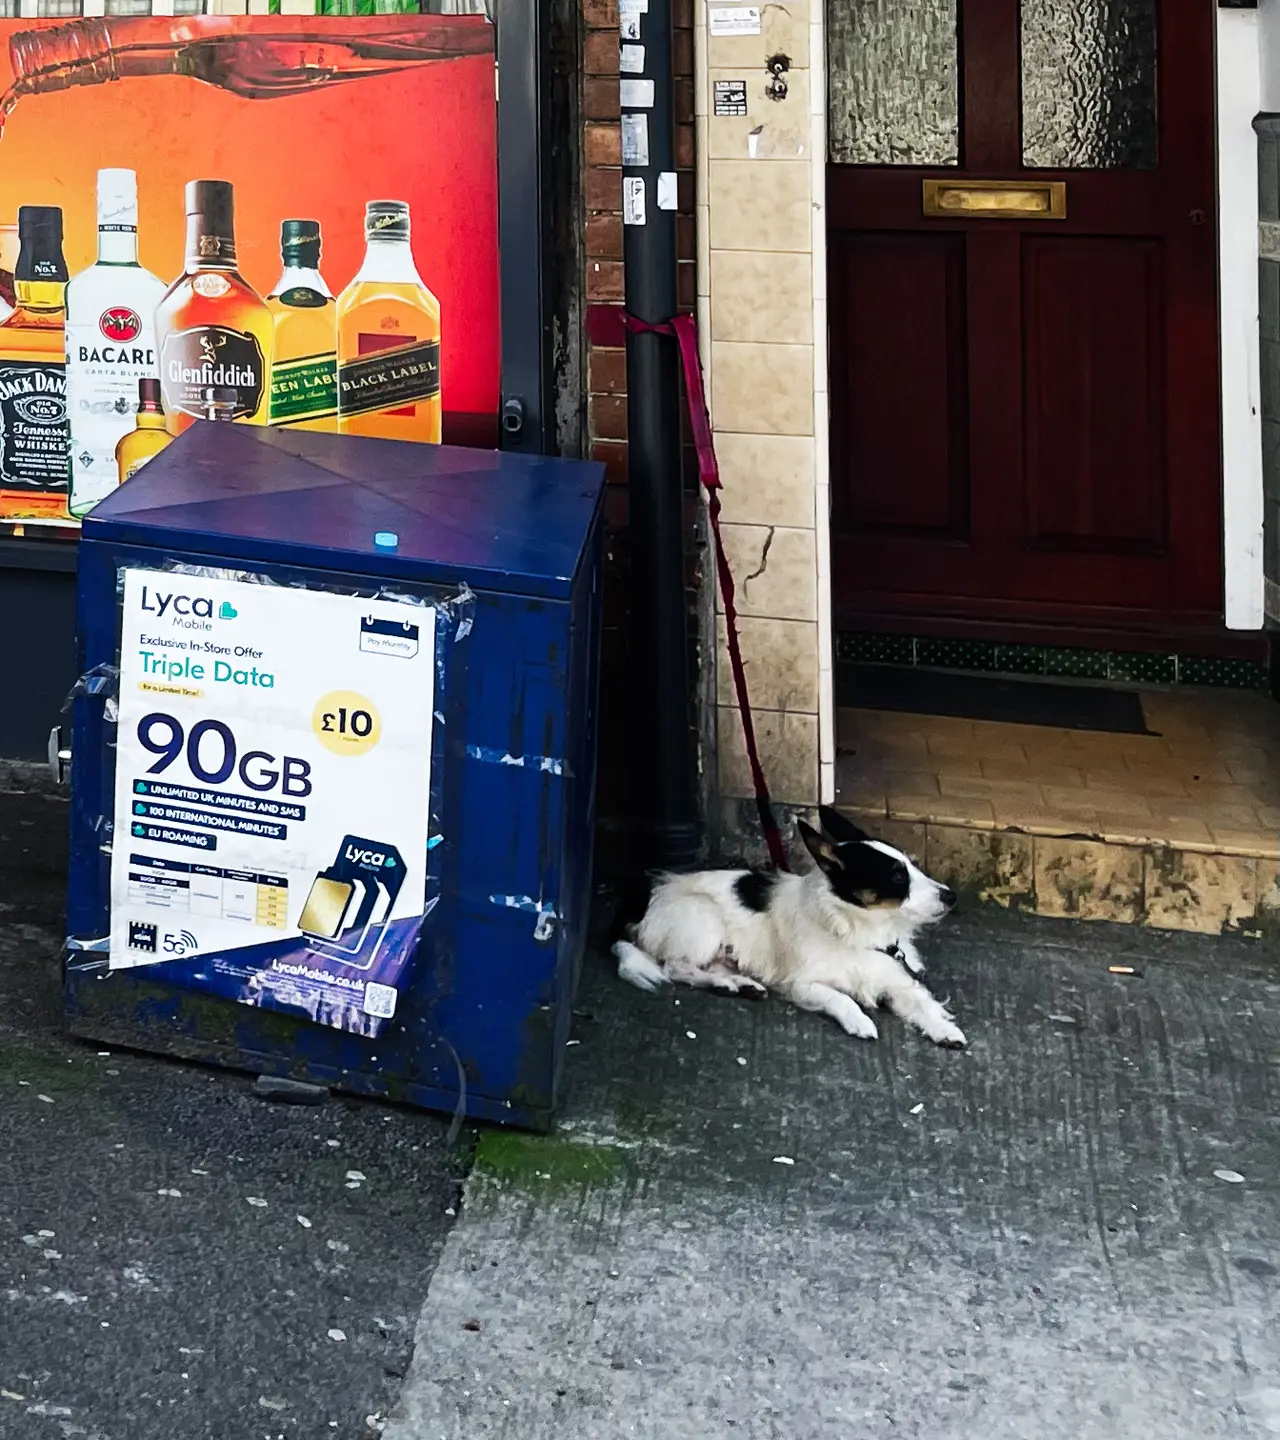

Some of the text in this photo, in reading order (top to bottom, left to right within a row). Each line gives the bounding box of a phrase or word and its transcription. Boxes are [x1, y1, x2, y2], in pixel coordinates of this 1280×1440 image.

[168, 359, 257, 388] Glenfiddich
[342, 360, 438, 393] BLACK LABEL
[141, 586, 213, 618] Lyca
[172, 617, 213, 632] Mobile
[140, 634, 264, 659] Exclusive In-Store Offer
[139, 650, 275, 689] Triple Data
[321, 708, 373, 737] £10
[137, 712, 313, 798] 90GB
[150, 784, 301, 818] UNLIMITED UK MINUTES AND SMS
[149, 806, 237, 830] 100 INTERNATIONAL
[148, 828, 208, 846] EU ROAMING
[345, 844, 386, 867] Lyca
[162, 933, 186, 955] 5G
[272, 958, 365, 991] LycaMobile.co.uk
